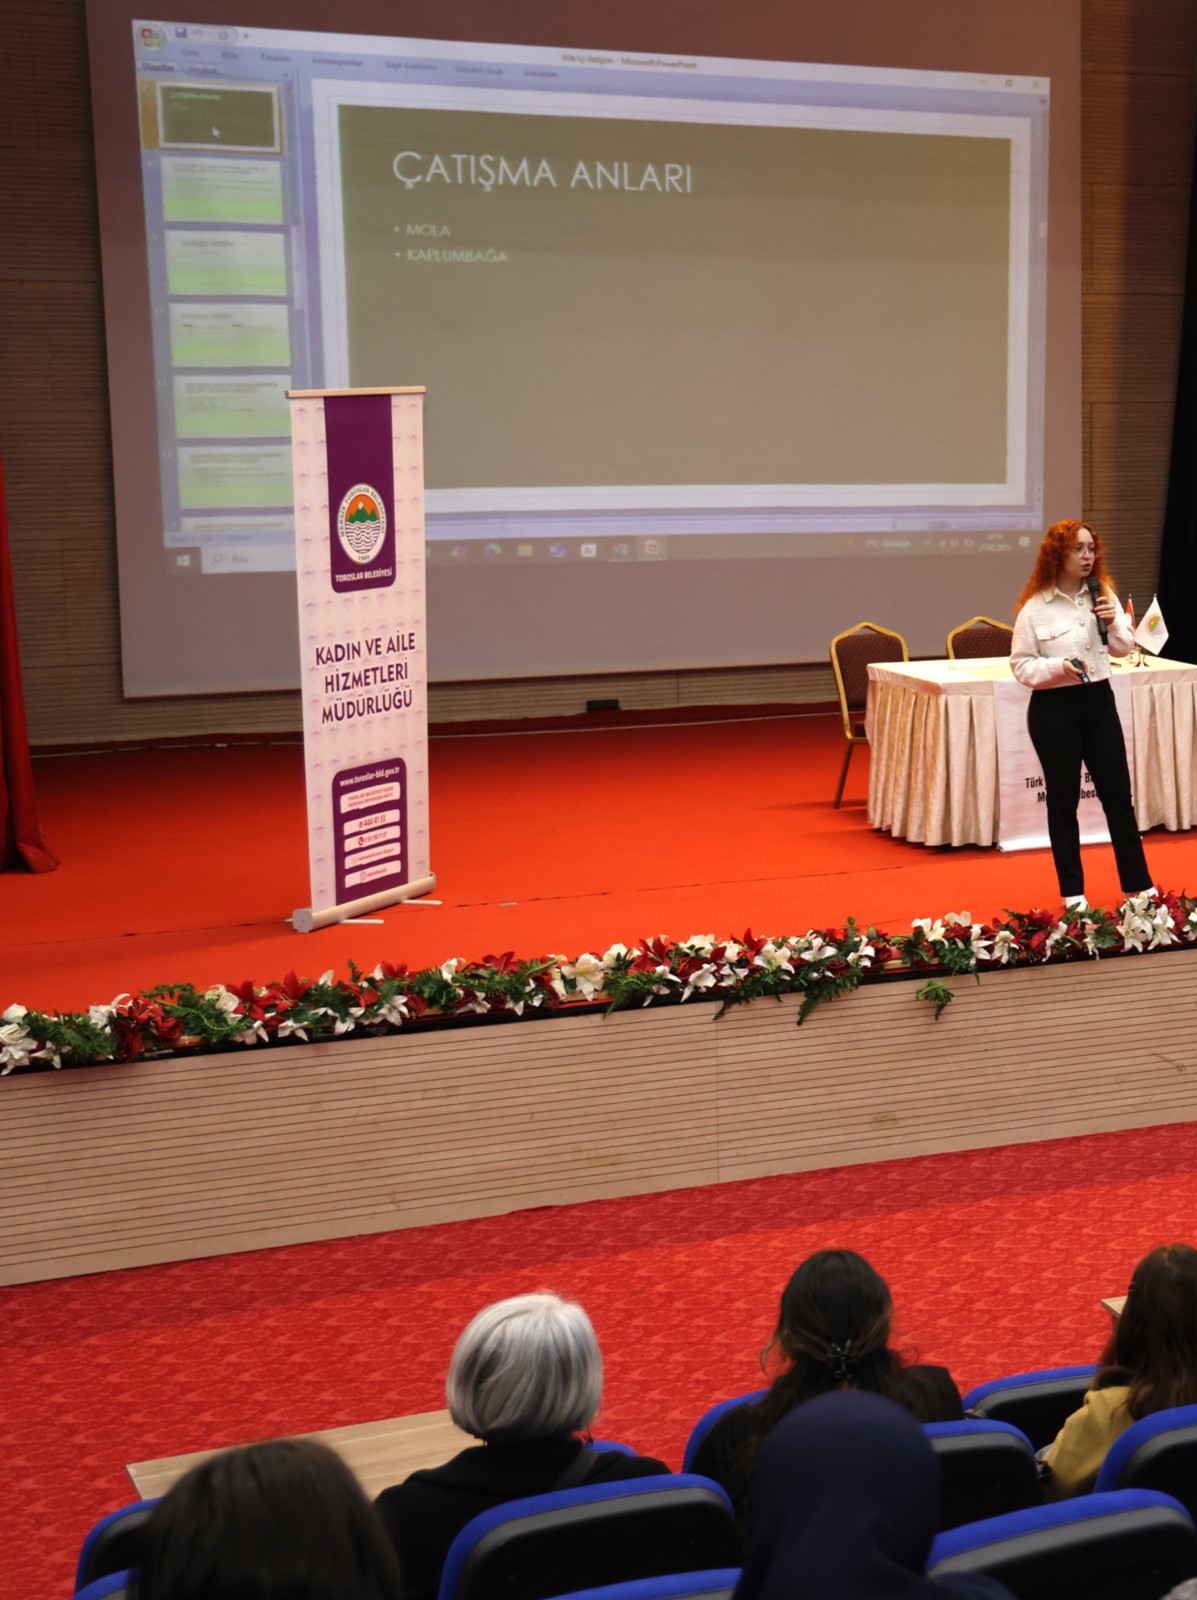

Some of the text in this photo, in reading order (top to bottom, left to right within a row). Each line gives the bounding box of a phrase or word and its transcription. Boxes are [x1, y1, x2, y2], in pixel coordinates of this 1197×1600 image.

[392, 151, 692, 193] ÇATIŞMA ANLARI
[406, 224, 451, 238] MOLA
[407, 249, 508, 263] KAPLUMBAĞA
[335, 566, 393, 583] TOROSLAR BELEDİYESİ
[315, 629, 416, 666] KADIN VE AİLE
[324, 656, 408, 694] HİZMETLERİ
[321, 684, 413, 725] MÜDÜRLÜĞÜ
[1025, 777, 1043, 789] Türk
